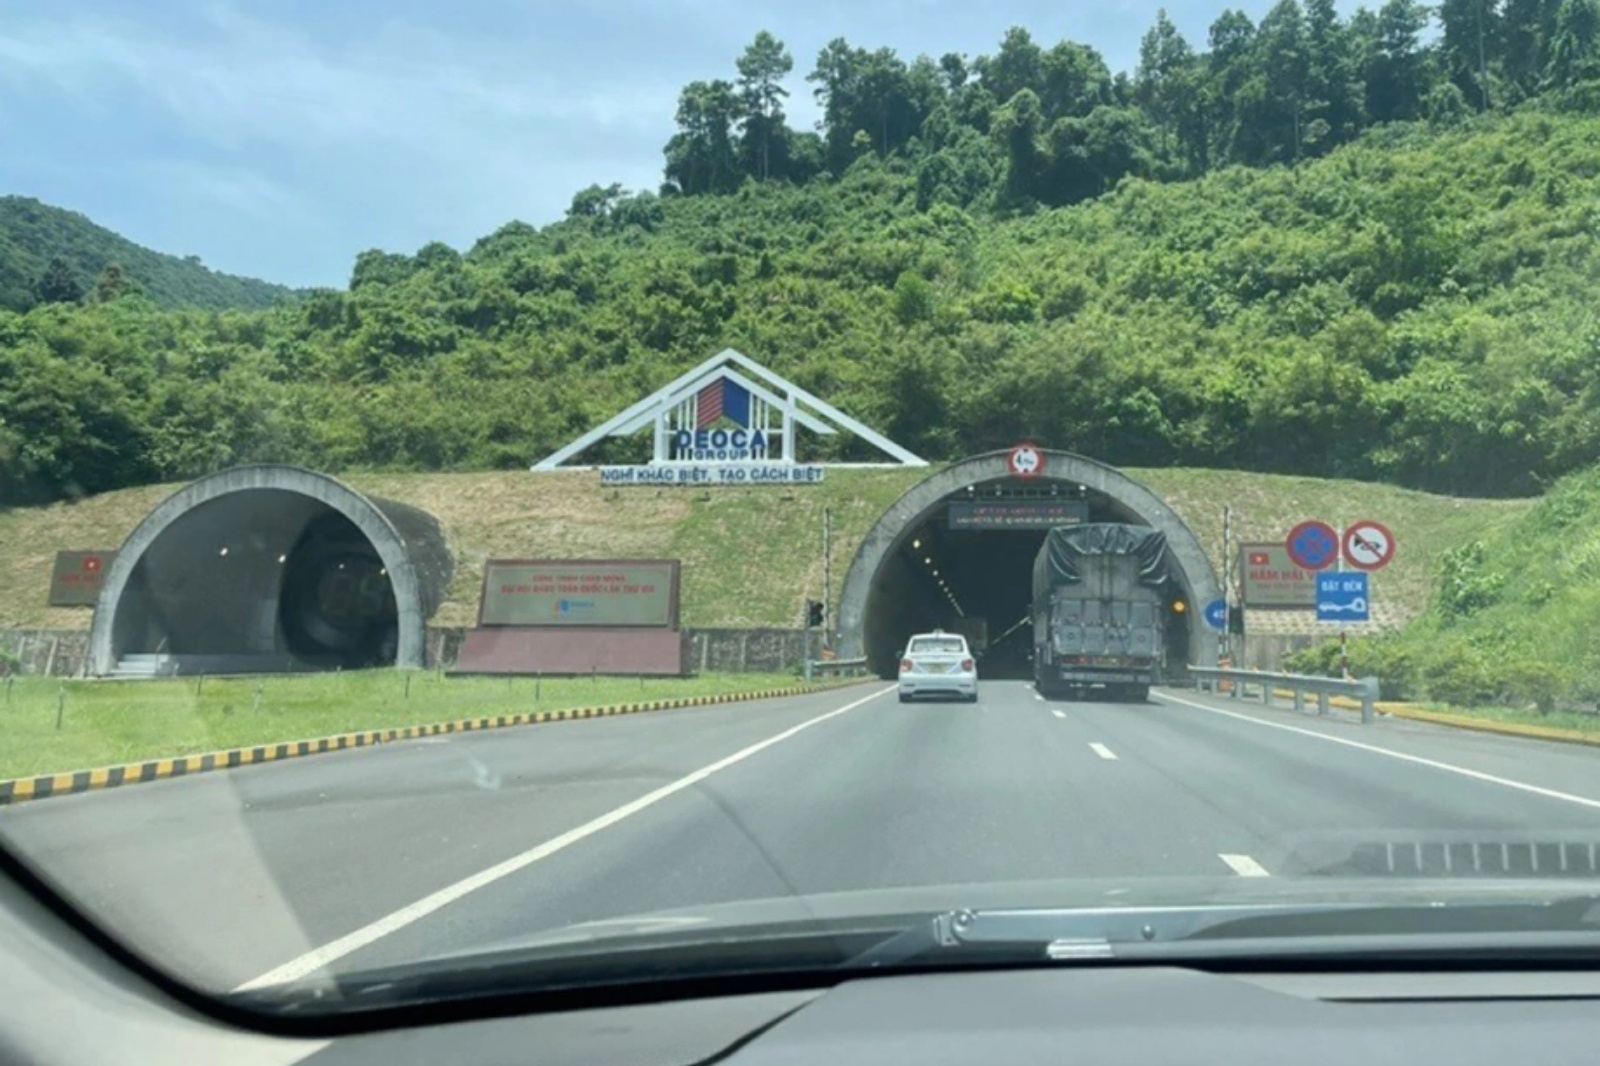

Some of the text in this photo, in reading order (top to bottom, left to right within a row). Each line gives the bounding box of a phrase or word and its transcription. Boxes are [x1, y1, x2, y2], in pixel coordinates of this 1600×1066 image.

[676, 429, 766, 449] DEOCA
[694, 449, 749, 460] GROUP
[637, 467, 674, 481] KHÁC
[750, 466, 788, 480] CÁCH
[792, 466, 823, 481] BIỆT
